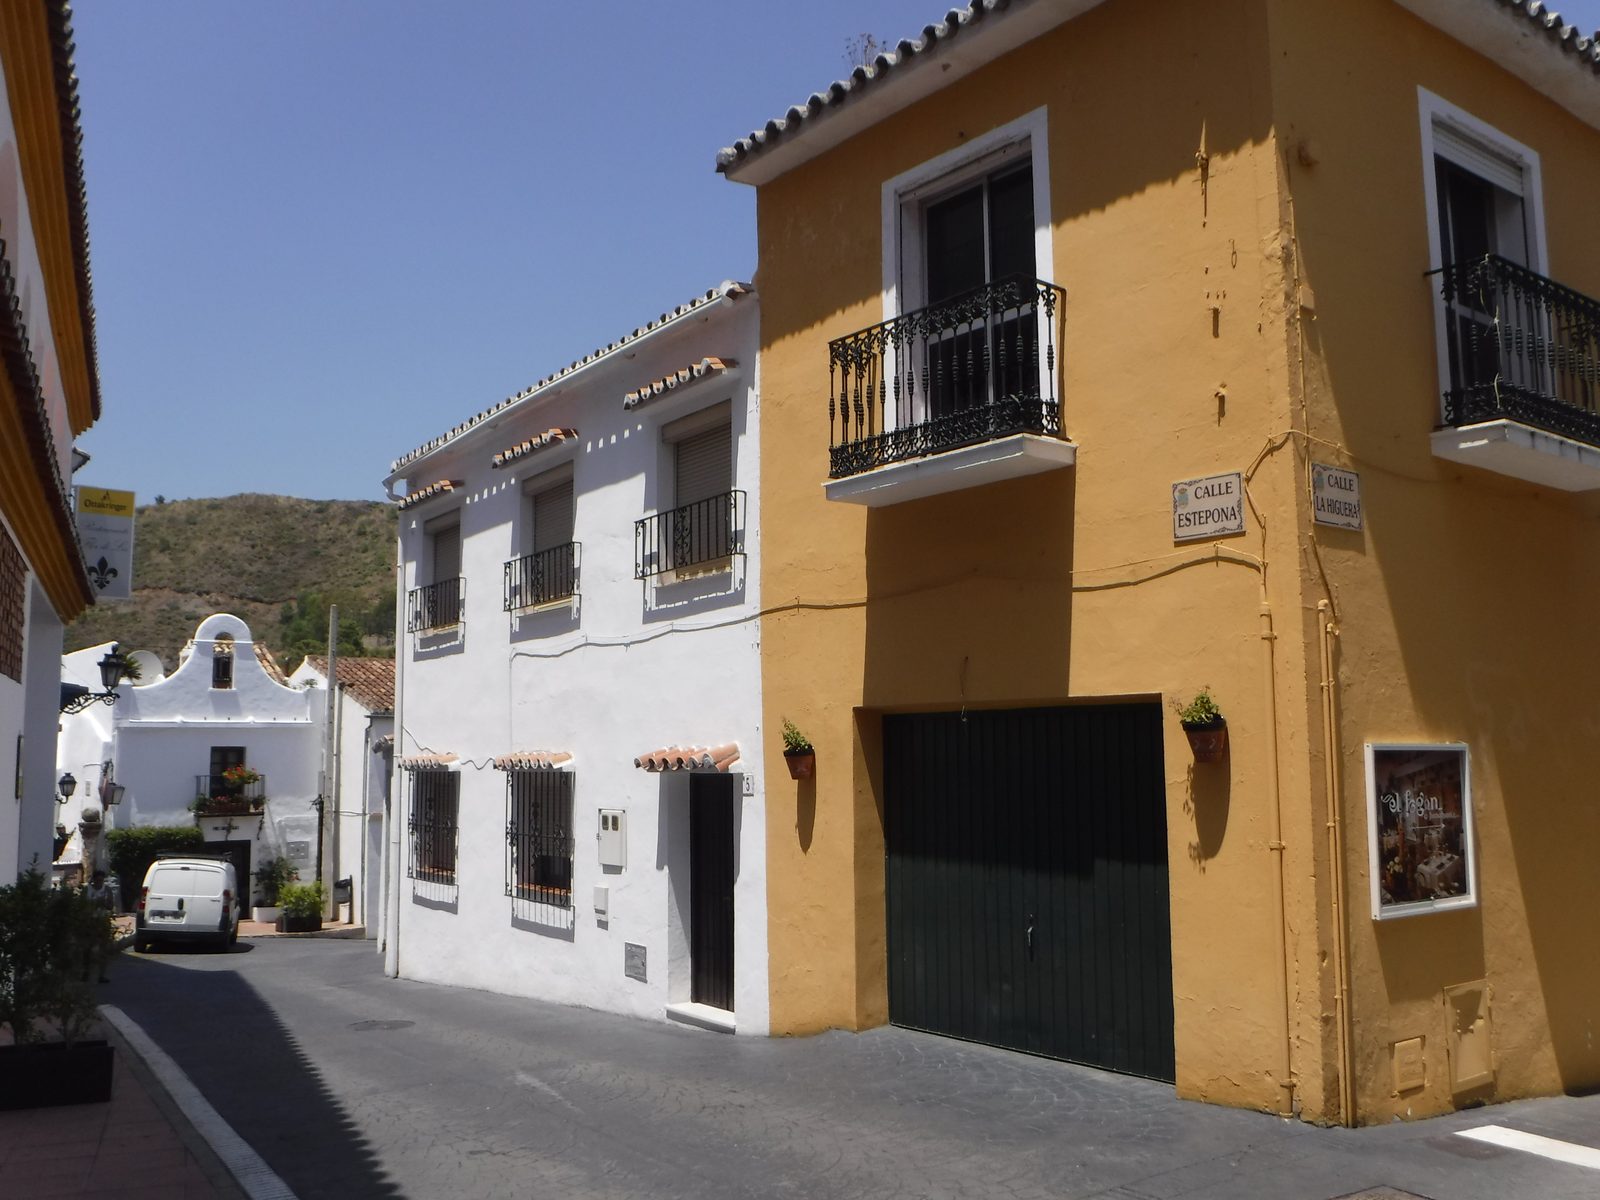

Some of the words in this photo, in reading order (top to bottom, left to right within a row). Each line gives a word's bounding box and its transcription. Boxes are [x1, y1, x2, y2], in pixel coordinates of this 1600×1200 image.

[1194, 481, 1233, 500] CALLE
[1327, 473, 1355, 492] CALLE
[1315, 495, 1326, 513] LA
[1326, 499, 1359, 519] HIGUERA
[1177, 506, 1238, 528] ESTEPONA
[745, 777, 751, 792] 5
